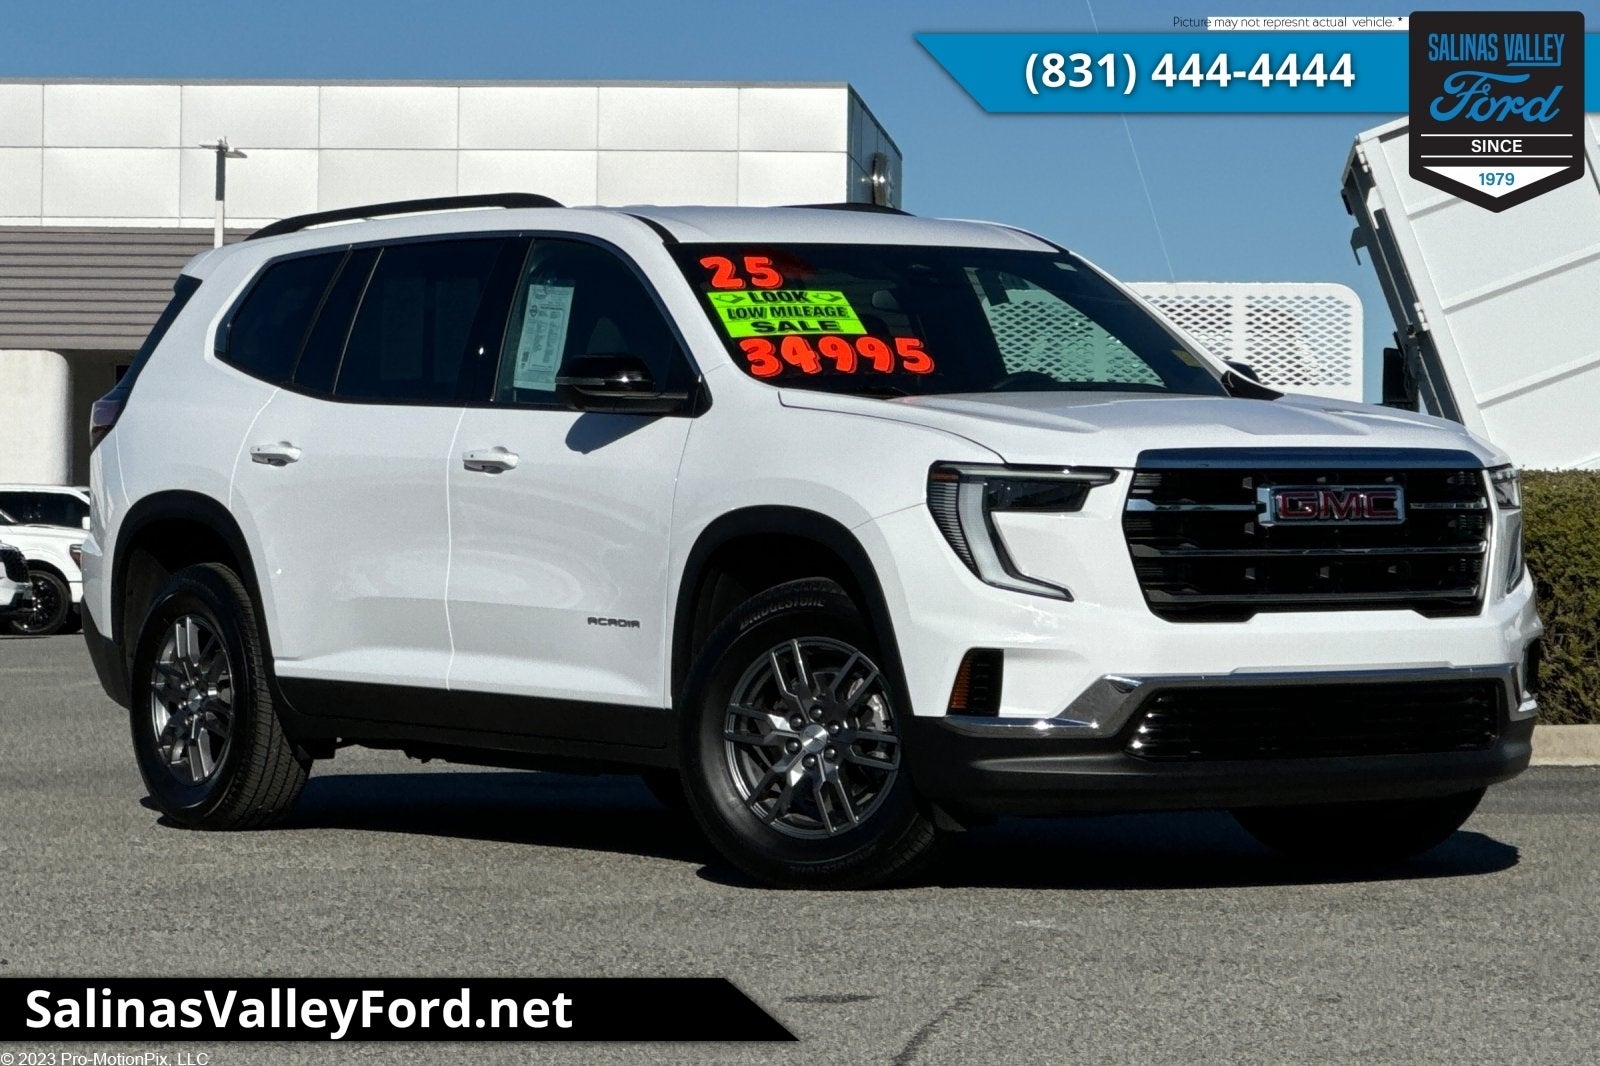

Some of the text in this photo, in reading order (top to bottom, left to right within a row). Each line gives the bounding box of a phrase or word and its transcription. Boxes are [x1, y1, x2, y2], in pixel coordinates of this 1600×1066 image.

[700, 256, 783, 289] 25
[748, 290, 811, 305] LOOK
[727, 304, 850, 321] LOW MILEAGE
[752, 320, 843, 334] SALE
[739, 335, 935, 377] 34995
[1276, 490, 1398, 520] GMC
[587, 616, 641, 629] ACADIA
